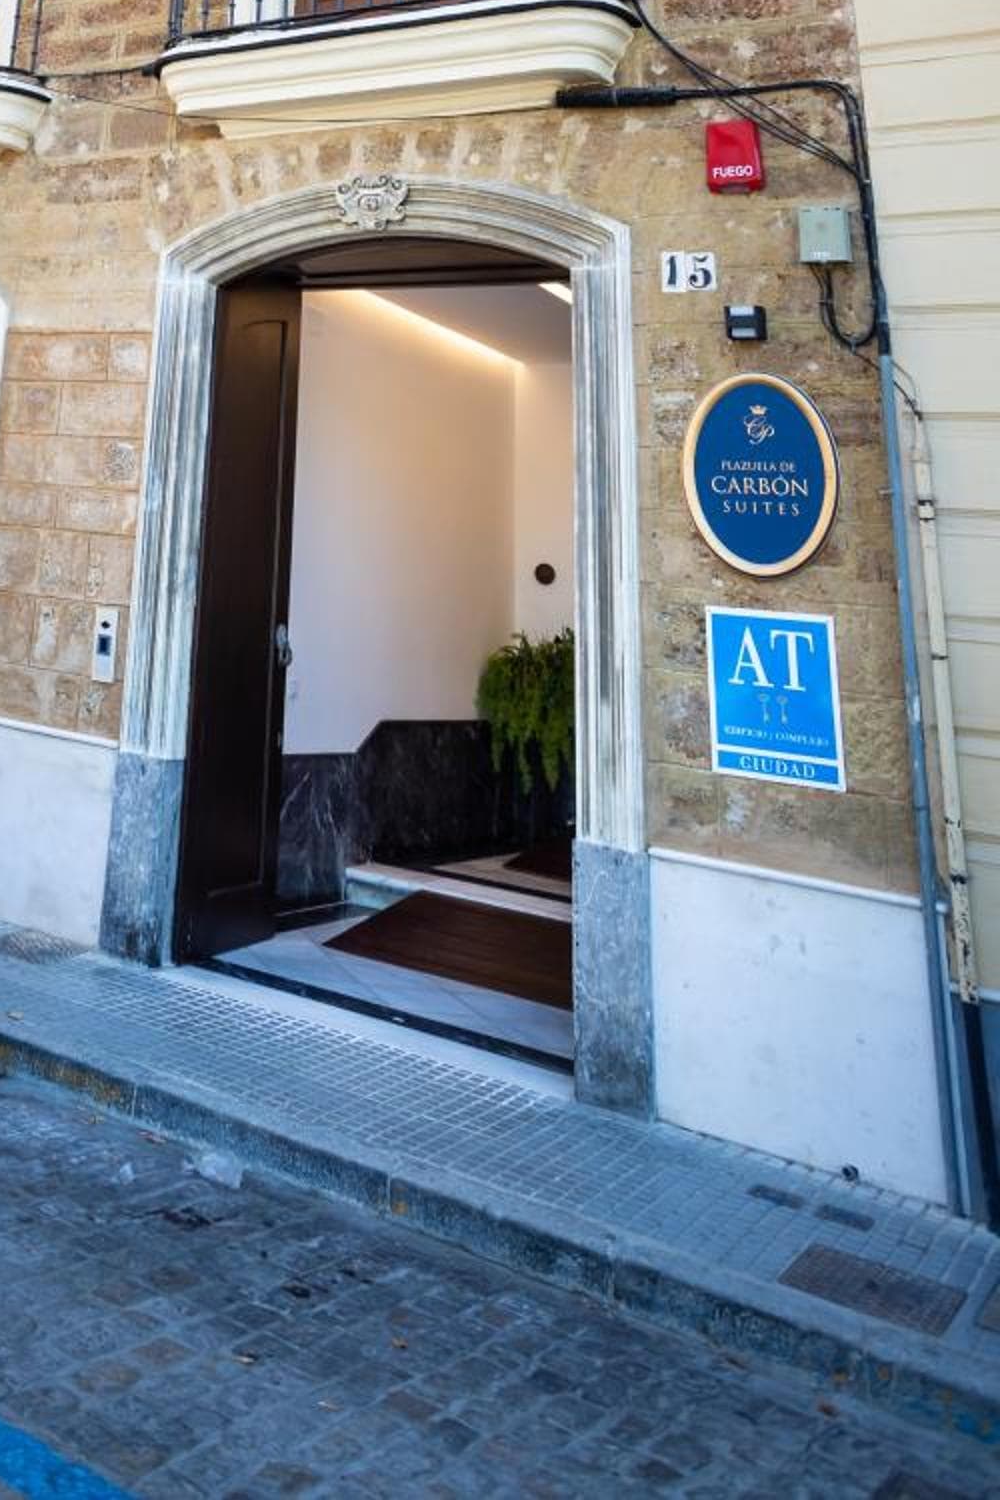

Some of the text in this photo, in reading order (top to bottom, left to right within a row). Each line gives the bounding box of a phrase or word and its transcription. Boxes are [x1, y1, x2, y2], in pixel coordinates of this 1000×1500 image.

[712, 165, 753, 178] FUEGO
[666, 255, 712, 288] 15
[721, 459, 797, 473] PLAZUELA DE
[723, 499, 800, 517] SUITES
[727, 625, 815, 692] AT
[739, 755, 816, 779] CIUDAD
